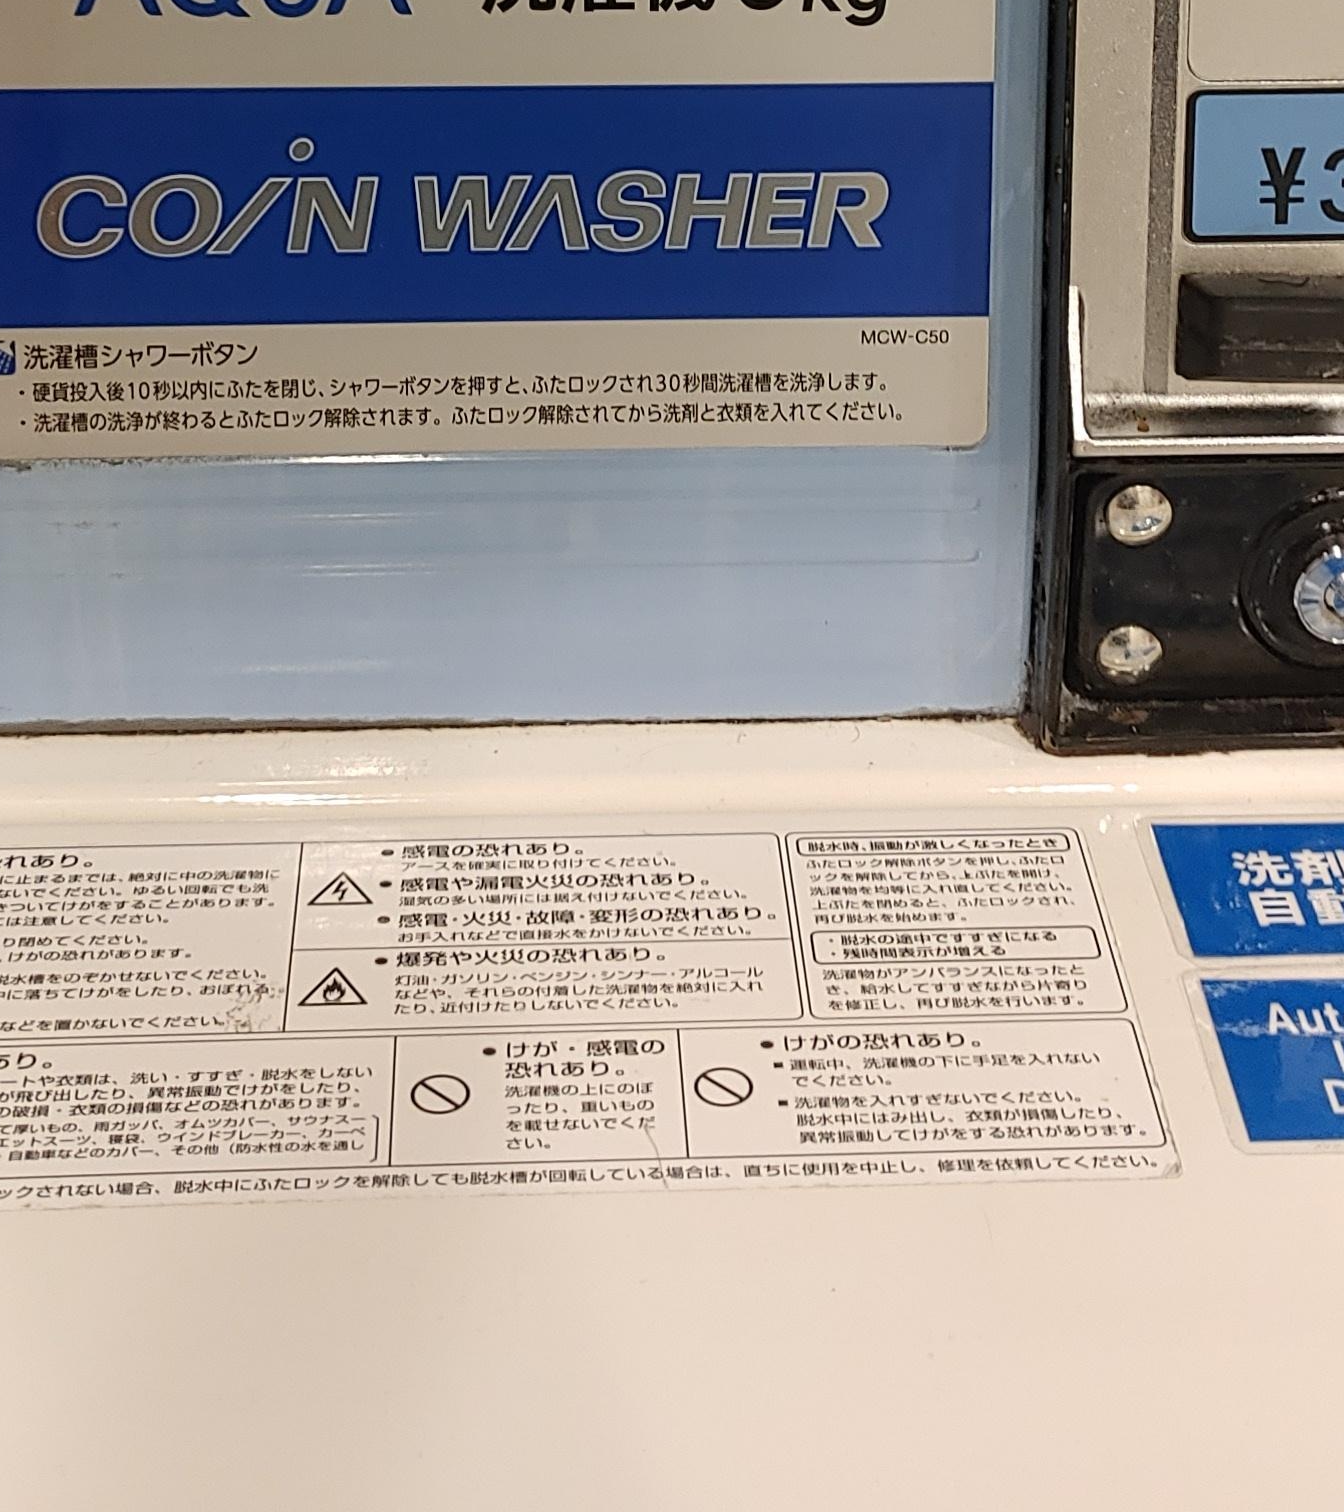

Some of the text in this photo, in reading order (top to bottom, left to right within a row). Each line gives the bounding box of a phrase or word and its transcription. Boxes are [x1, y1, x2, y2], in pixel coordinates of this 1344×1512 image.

[35, 136, 891, 258] COIN WASHER
[860, 329, 950, 346] MCW-C50
[23, 342, 258, 370] 洗濯槽シャワーボタン
[401, 843, 584, 859] 感電の恐れあり。
[396, 946, 667, 968] 爆発や火災の恐れあり。
[506, 1039, 665, 1059] けが・感電の
[783, 1031, 982, 1051] けがの恐れあり。
[505, 1061, 624, 1079] 恐れあり。
[792, 1074, 892, 1088] でください。
[506, 1137, 552, 1151] さい。
